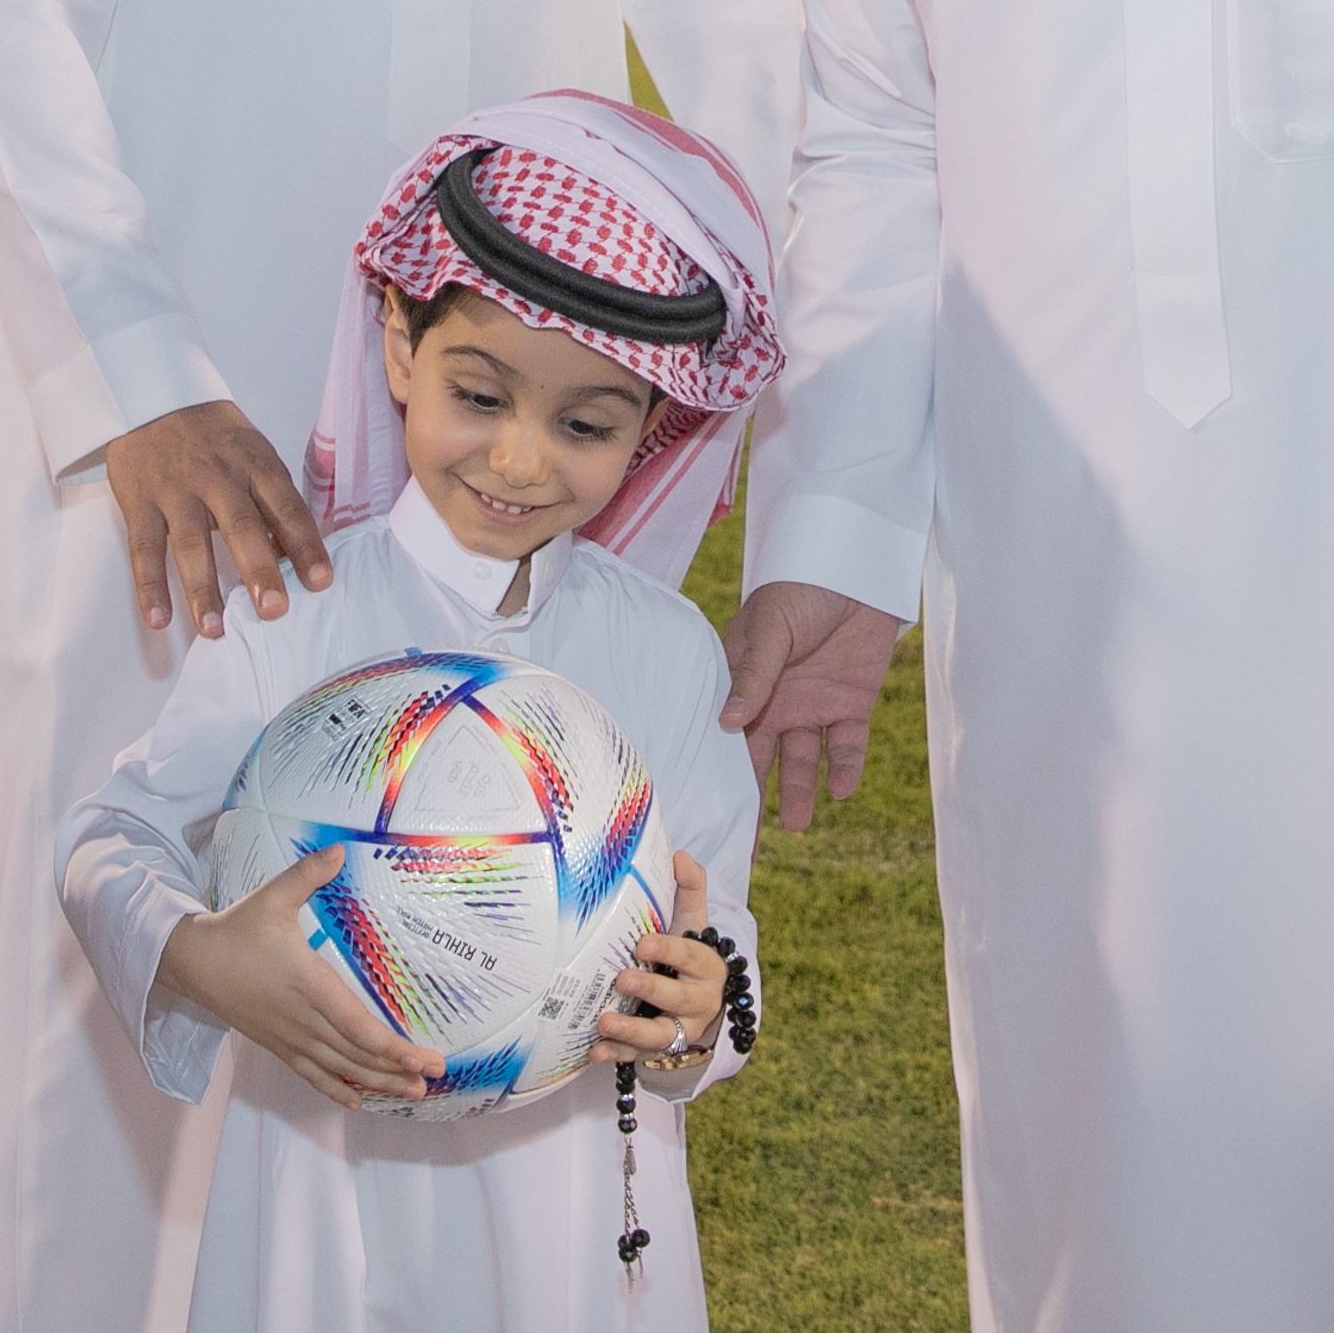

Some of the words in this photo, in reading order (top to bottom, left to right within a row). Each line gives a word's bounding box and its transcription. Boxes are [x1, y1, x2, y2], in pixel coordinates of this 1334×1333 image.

[347, 698, 365, 719] FIFA
[412, 916, 435, 932] MATCH
[432, 928, 477, 961] RIHLA
[479, 951, 498, 971] AL
